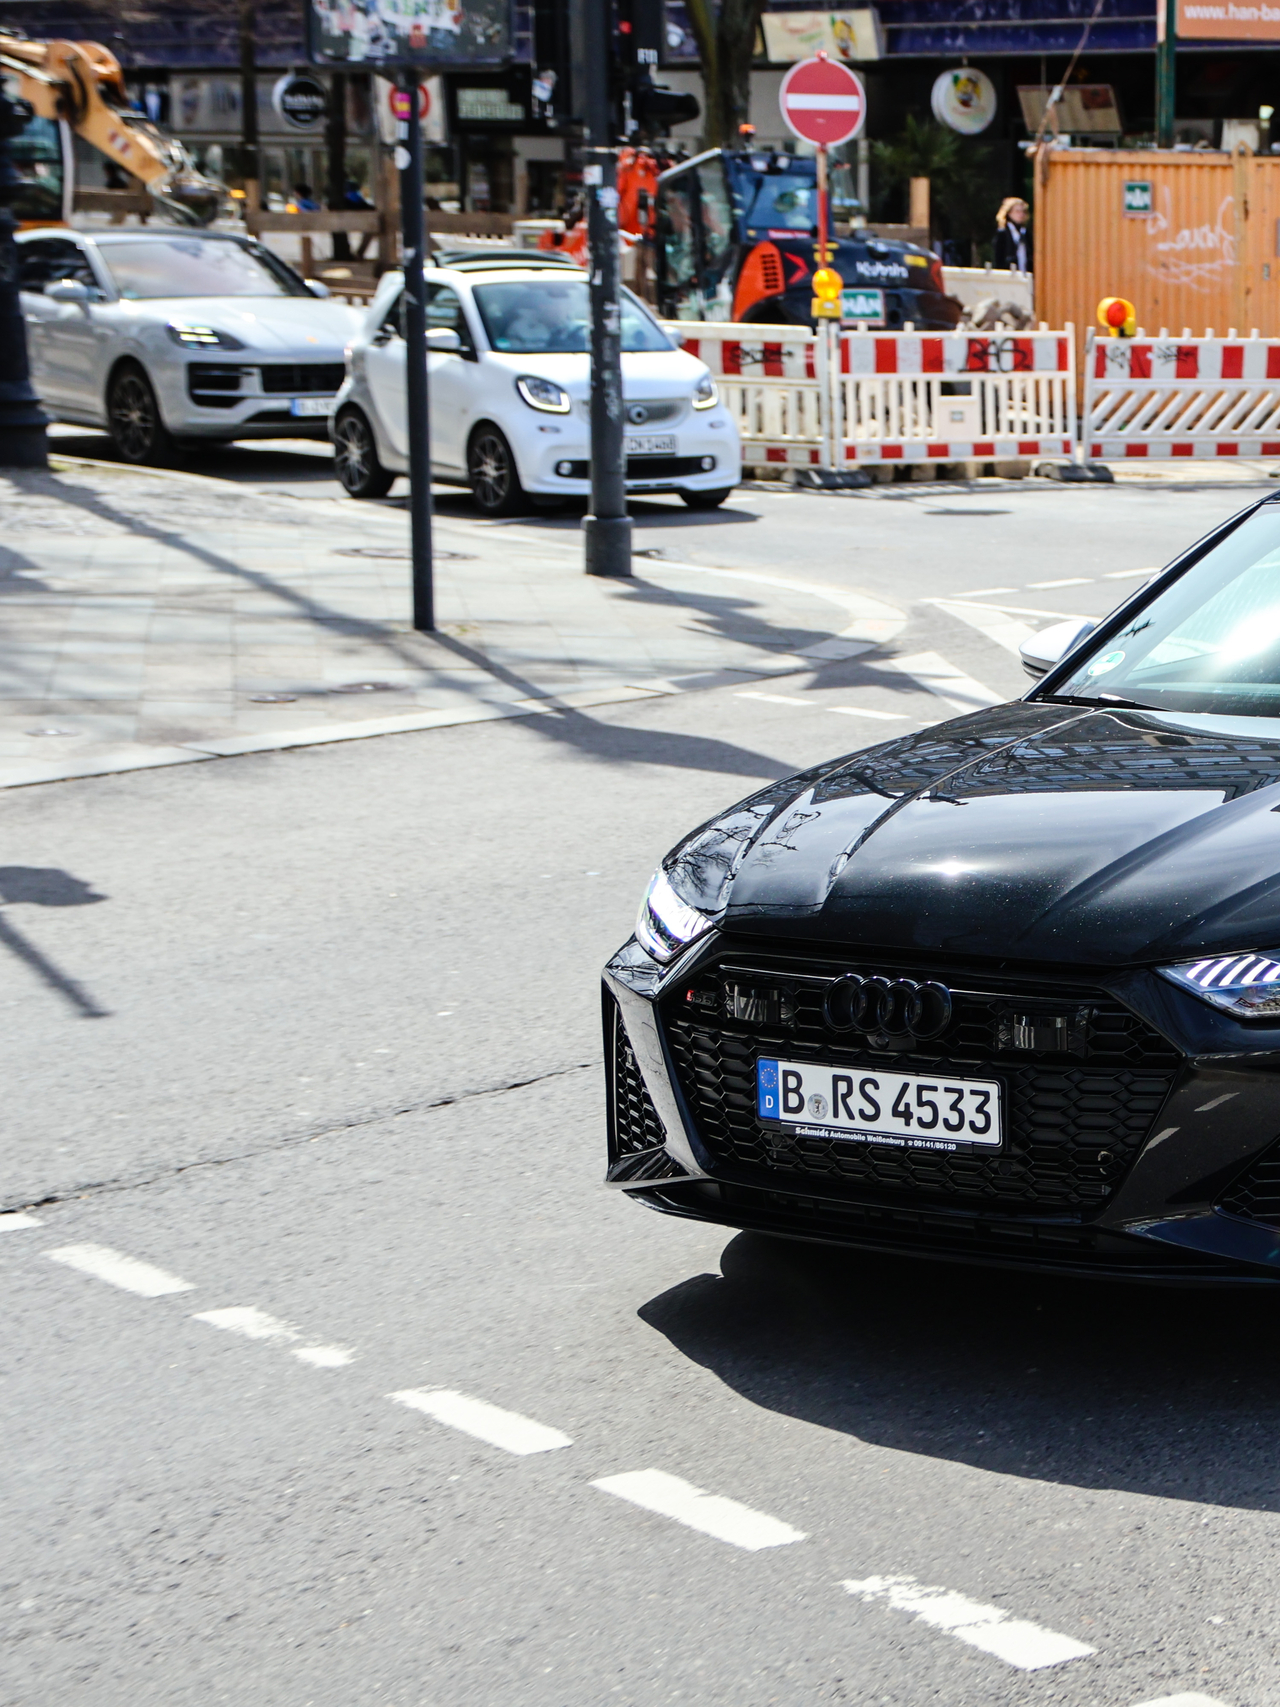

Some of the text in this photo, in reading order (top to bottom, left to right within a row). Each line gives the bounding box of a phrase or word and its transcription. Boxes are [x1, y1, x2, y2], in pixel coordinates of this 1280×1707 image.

[765, 1095, 774, 1109] D
[782, 1069, 992, 1135] B RS 4533
[795, 1126, 829, 1138] Schmidt
[829, 1130, 866, 1142] Automobile
[866, 1134, 905, 1146] Weißenburg
